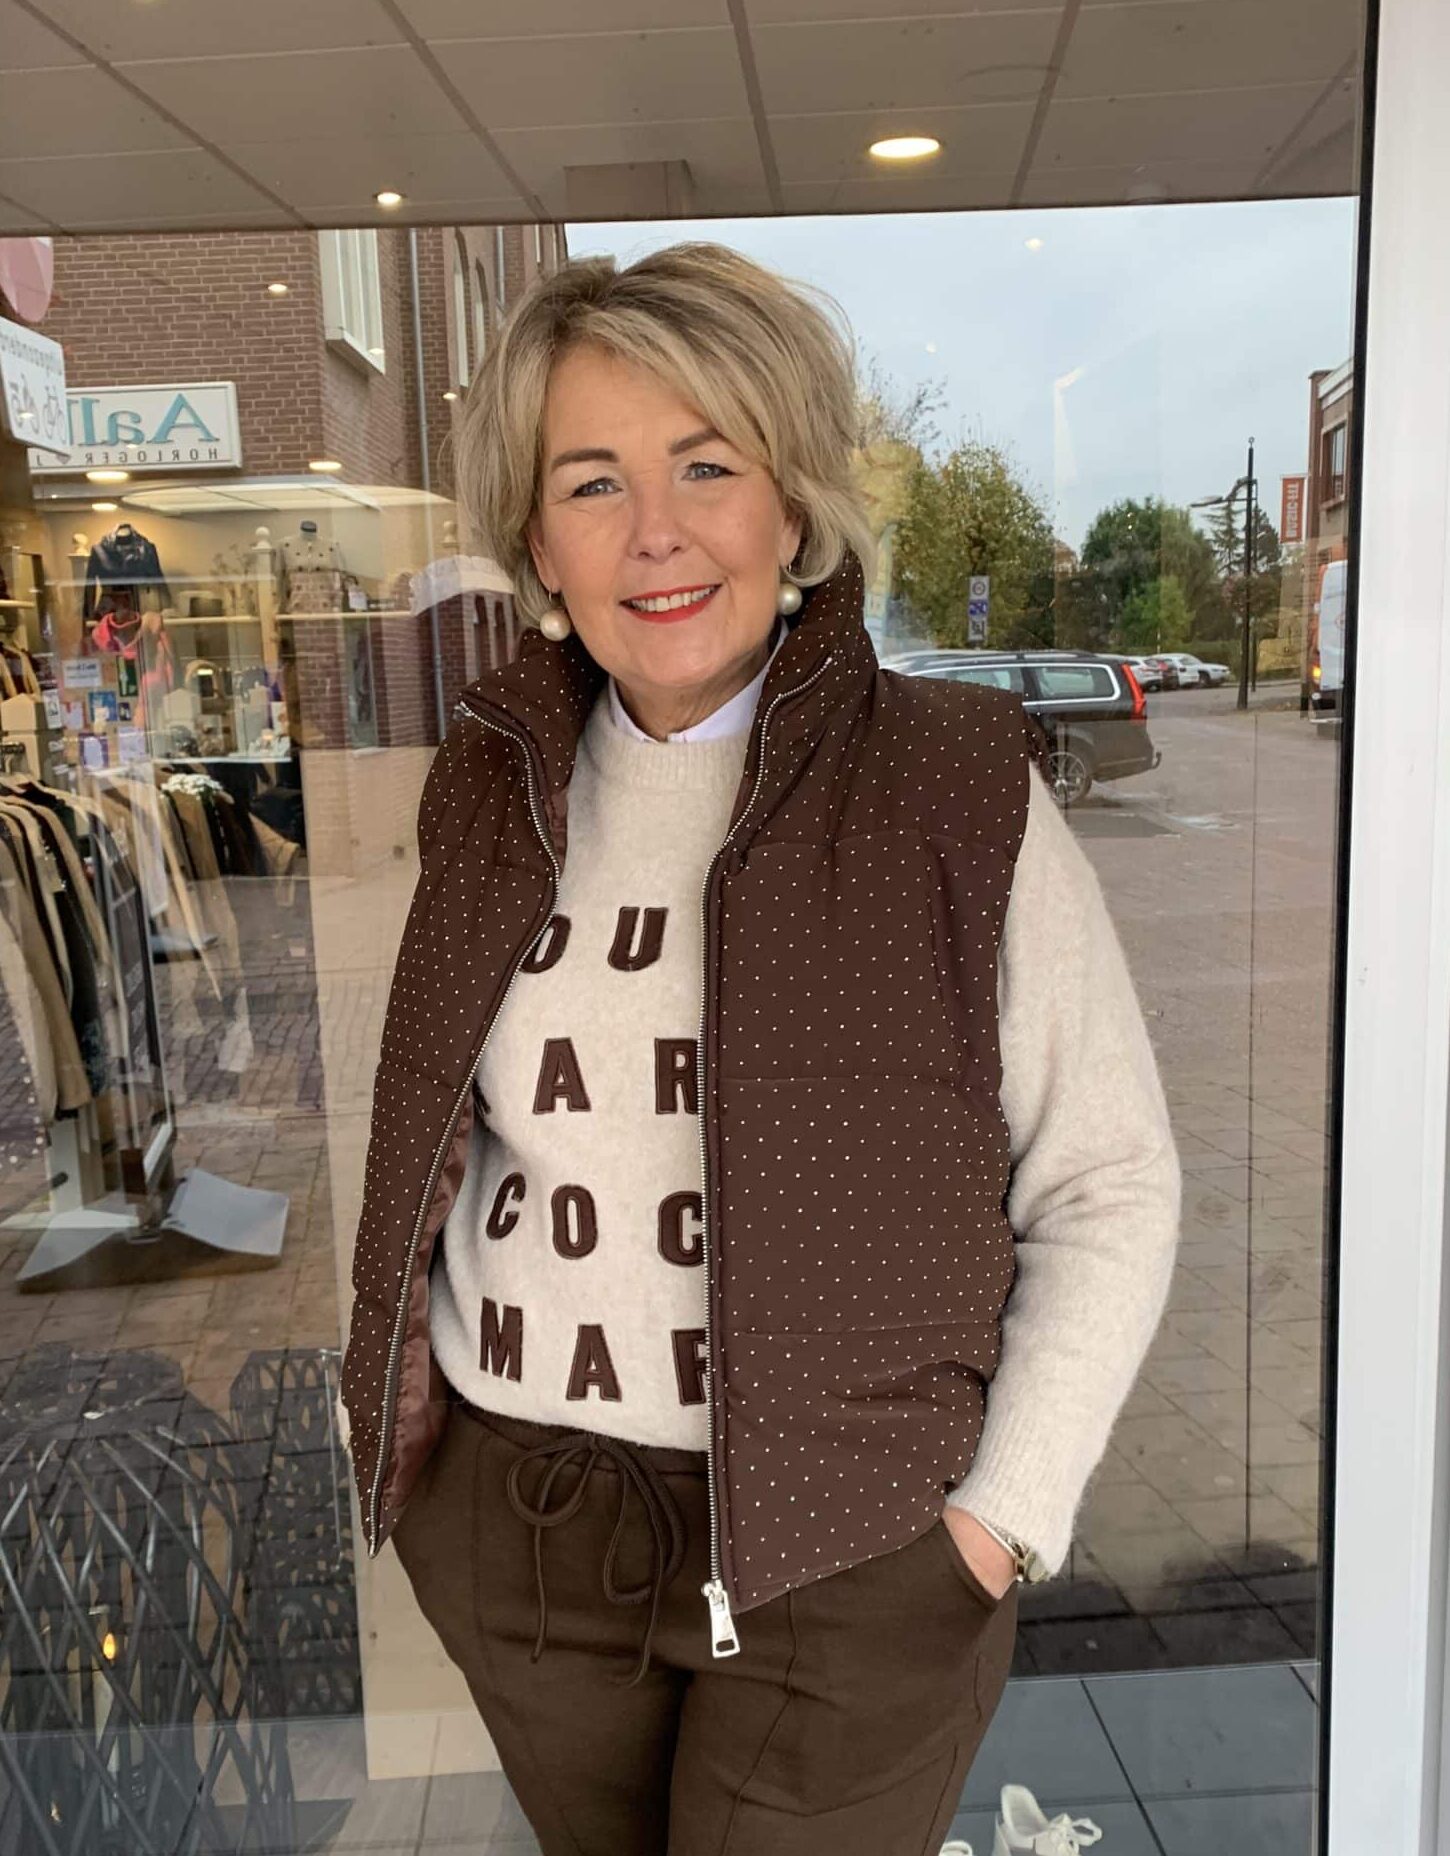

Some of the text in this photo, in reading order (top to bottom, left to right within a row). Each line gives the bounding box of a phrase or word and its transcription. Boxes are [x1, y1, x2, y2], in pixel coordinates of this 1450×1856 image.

[520, 906, 668, 974] OU
[472, 1037, 698, 1115] AR
[485, 1171, 706, 1267] COC
